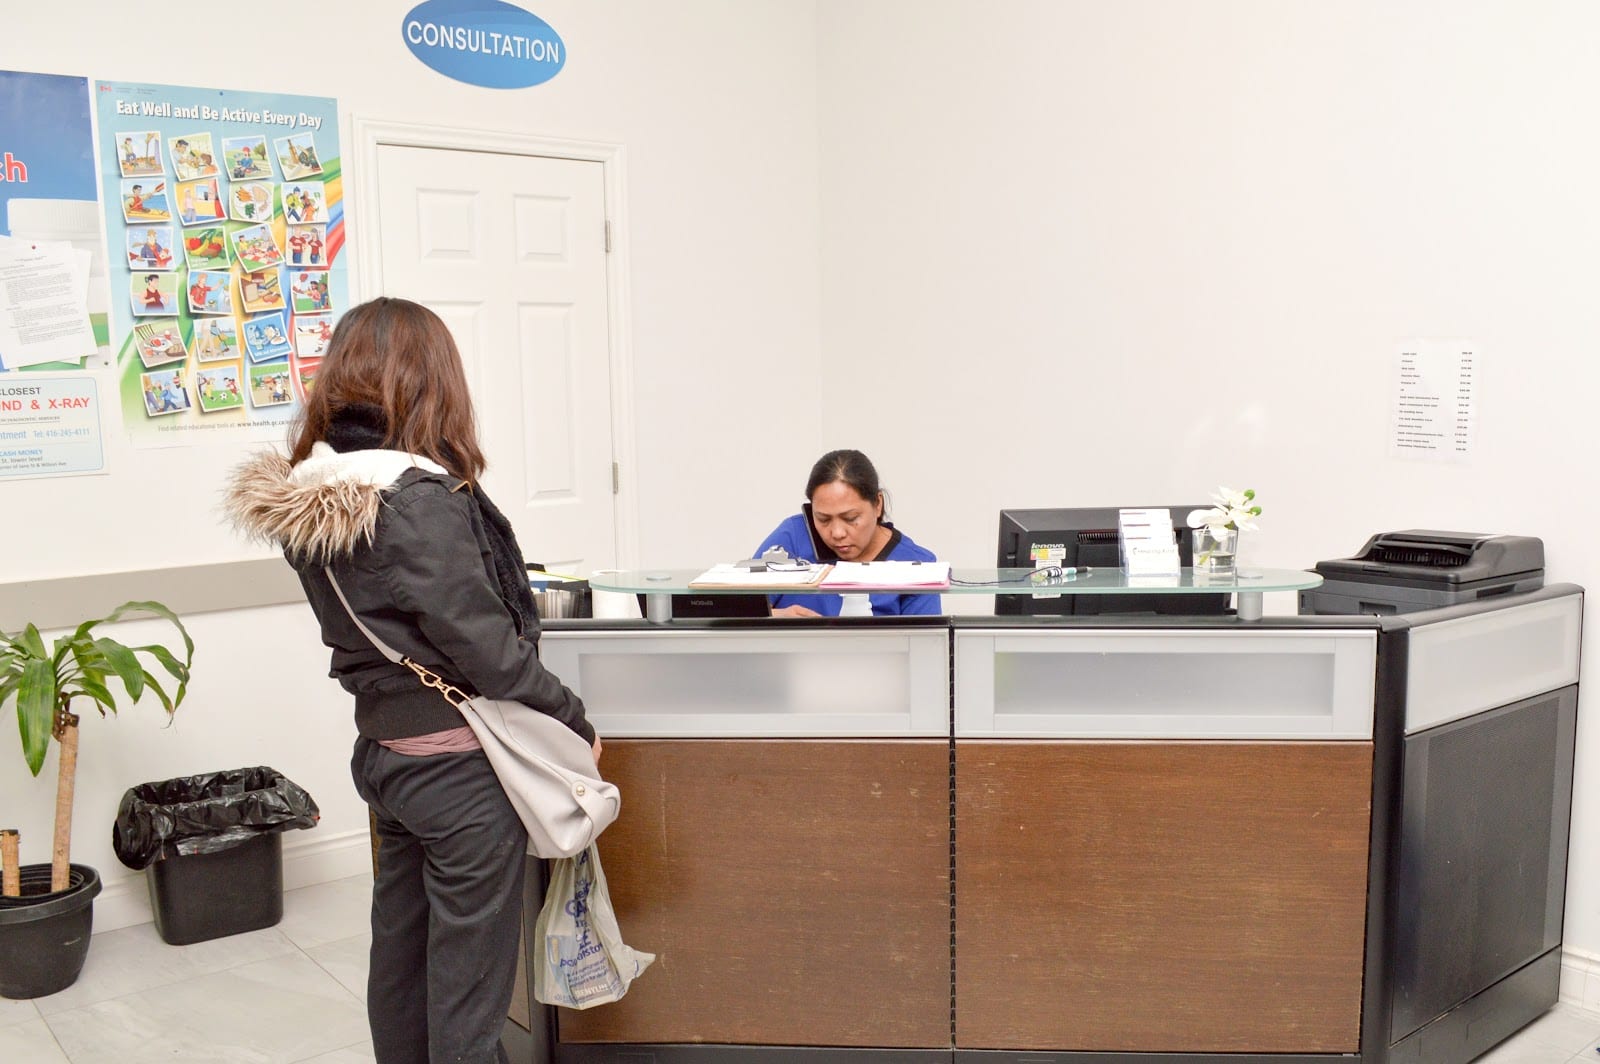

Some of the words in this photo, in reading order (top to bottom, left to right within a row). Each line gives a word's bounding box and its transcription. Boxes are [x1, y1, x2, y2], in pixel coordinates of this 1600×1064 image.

[407, 20, 560, 64] CONSULTATION
[116, 99, 139, 115] Eat
[141, 101, 171, 117] Well
[174, 105, 199, 119] and
[202, 106, 219, 120] Be
[222, 107, 261, 123] Active
[263, 110, 297, 129] Every
[299, 112, 322, 130] Day
[0, 152, 28, 182] h
[0, 400, 22, 411] ND
[30, 399, 40, 410] &
[48, 397, 90, 409] X-RAY
